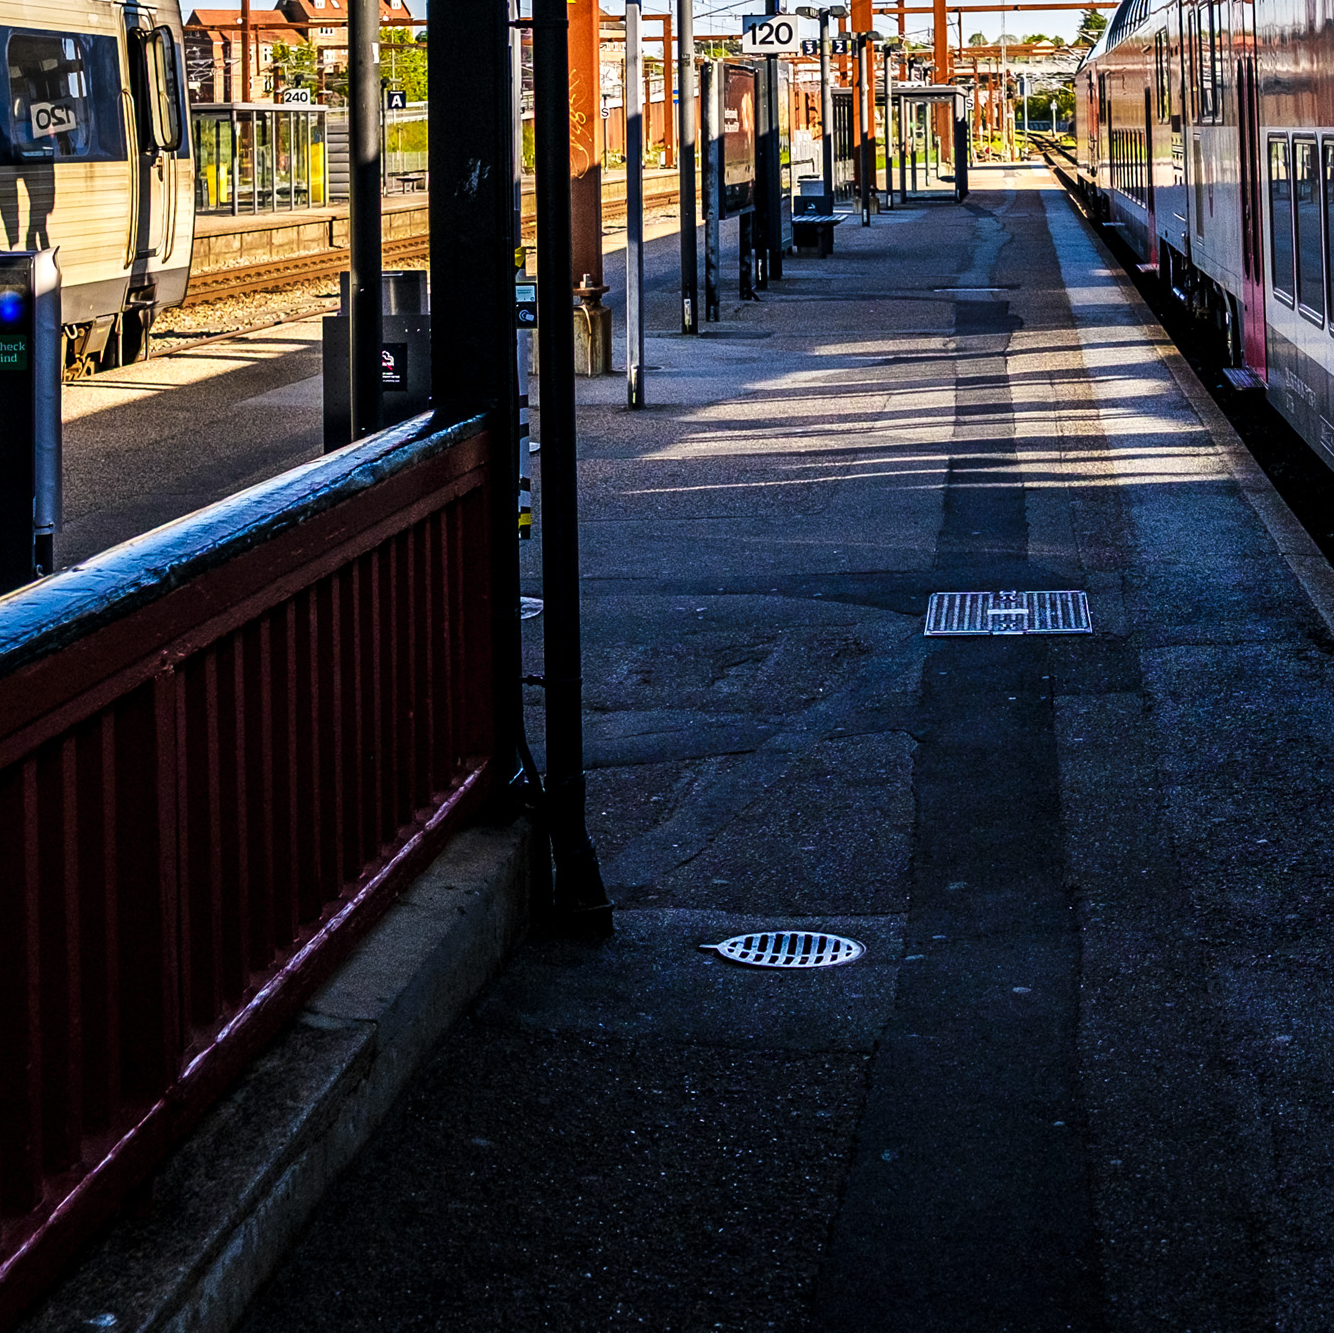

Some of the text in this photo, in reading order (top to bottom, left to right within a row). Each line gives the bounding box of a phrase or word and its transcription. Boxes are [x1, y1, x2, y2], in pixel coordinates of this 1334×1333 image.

[748, 22, 793, 46] 120
[805, 44, 814, 54] 3
[835, 44, 844, 53] 2
[284, 92, 309, 103] 240
[391, 95, 403, 107] A
[966, 98, 974, 109] S
[601, 107, 610, 117] S
[0, 353, 19, 363] ind
